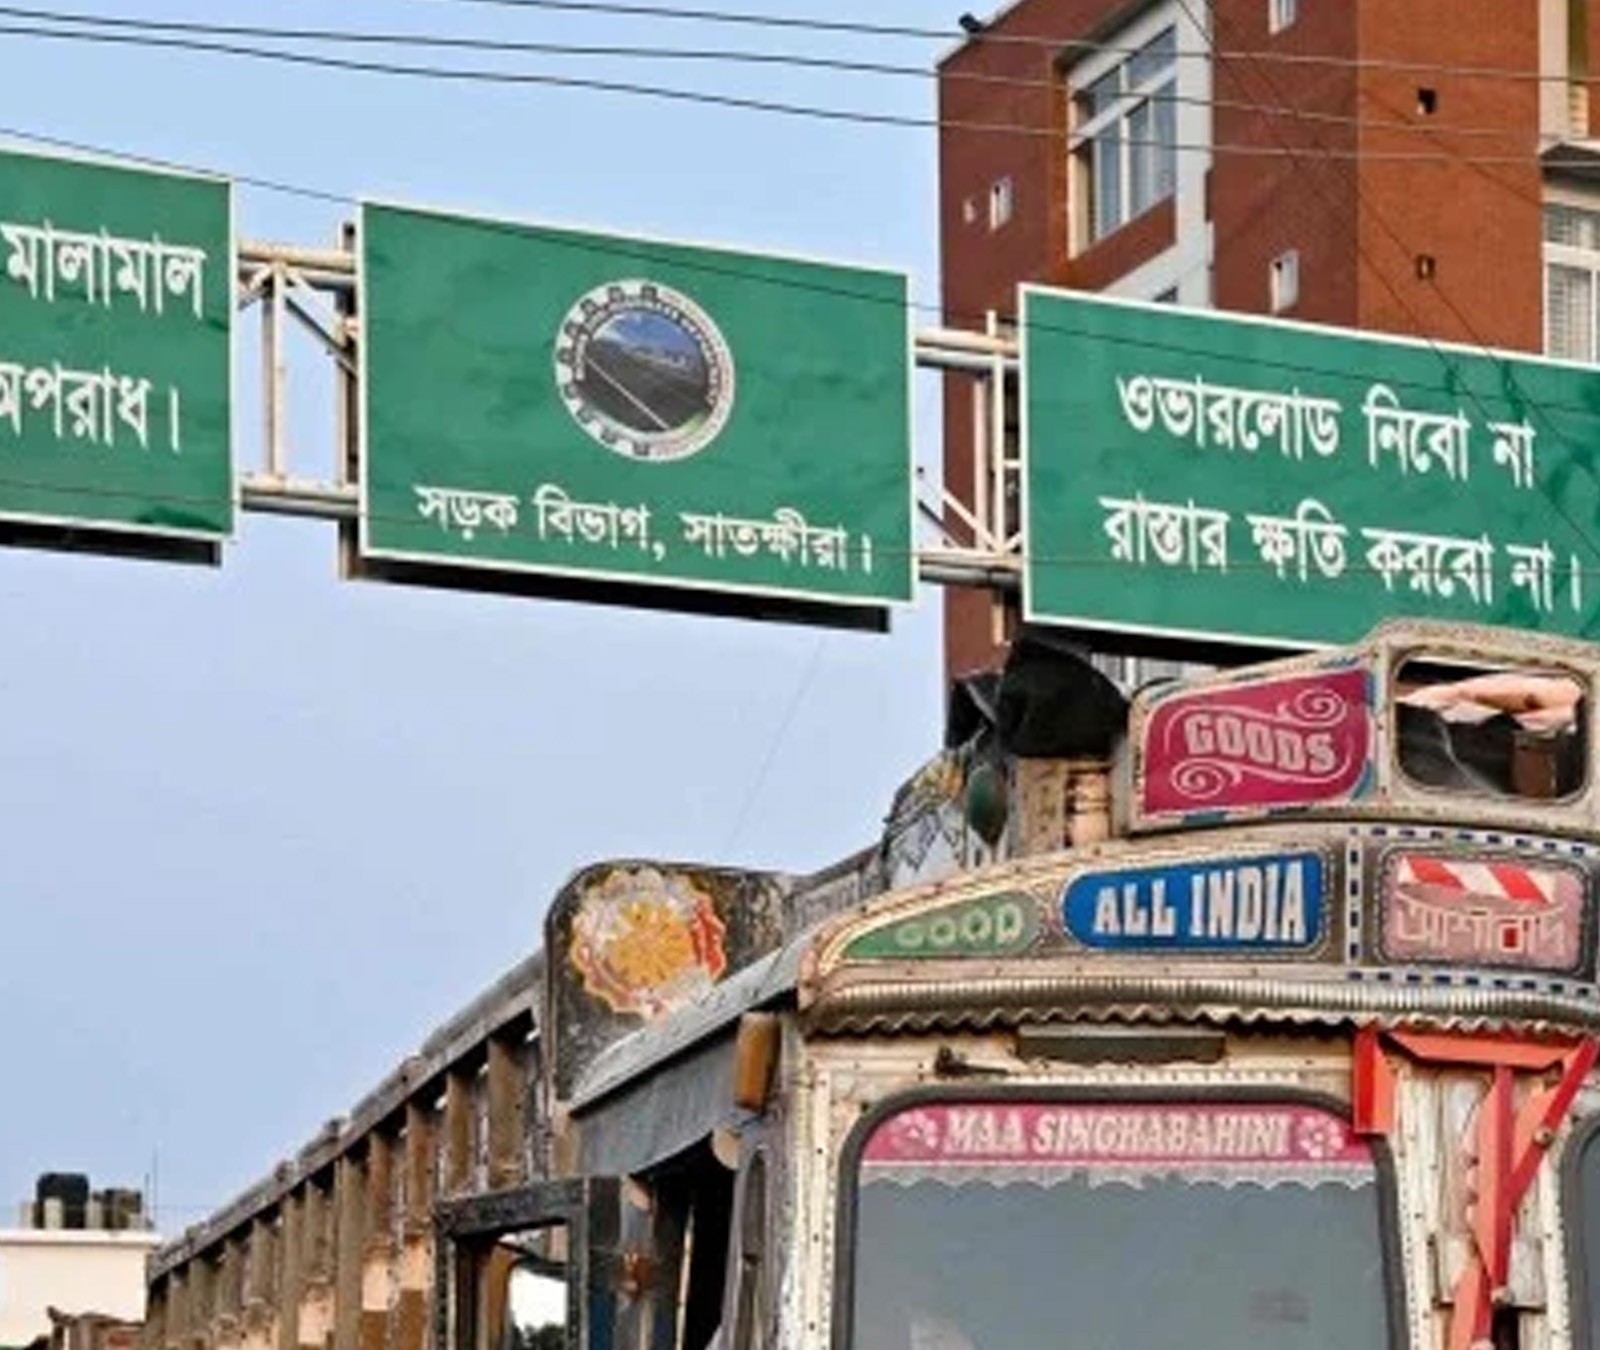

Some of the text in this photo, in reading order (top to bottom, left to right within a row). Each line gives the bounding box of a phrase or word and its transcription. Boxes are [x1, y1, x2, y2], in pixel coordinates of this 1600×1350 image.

[0, 222, 207, 317] মালামাল
[1117, 375, 1536, 488] ওভারলোড নিবো না
[414, 485, 519, 541] সড়ক
[1099, 492, 1230, 571] রাস্তার
[1246, 499, 1348, 581] ক্ষতি
[1362, 528, 1494, 606] করবো
[1183, 713, 1338, 776] GOODS
[1093, 860, 1308, 944] ALL INDIA
[944, 1107, 1295, 1158] MAA SINGHABAHINI
